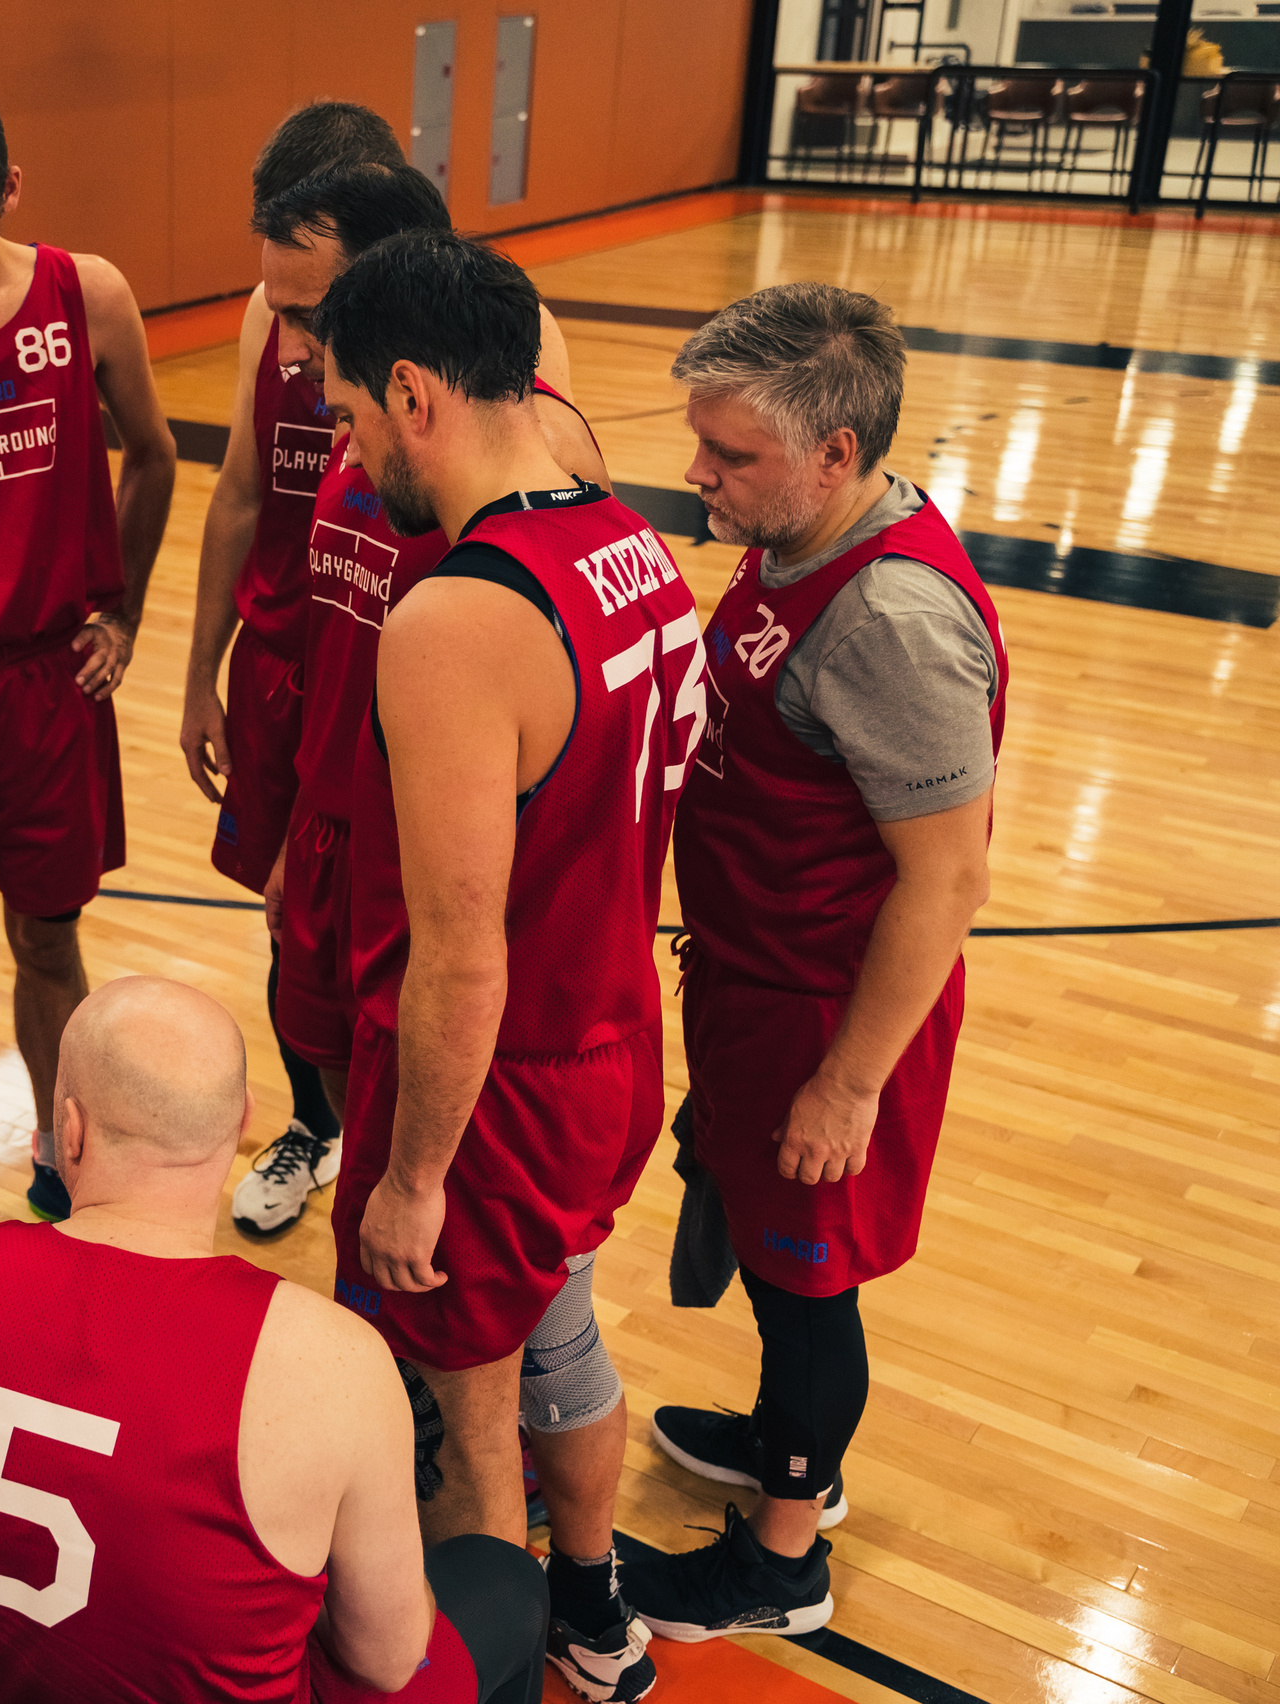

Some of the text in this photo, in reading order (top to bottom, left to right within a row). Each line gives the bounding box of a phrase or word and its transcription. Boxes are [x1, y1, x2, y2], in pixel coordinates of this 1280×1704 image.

[15, 321, 72, 373] 86
[273, 447, 330, 473] PLAYG
[734, 603, 790, 679] 20
[601, 606, 708, 823] 73
[906, 766, 968, 792] TARMAK
[334, 1278, 381, 1315] ARD
